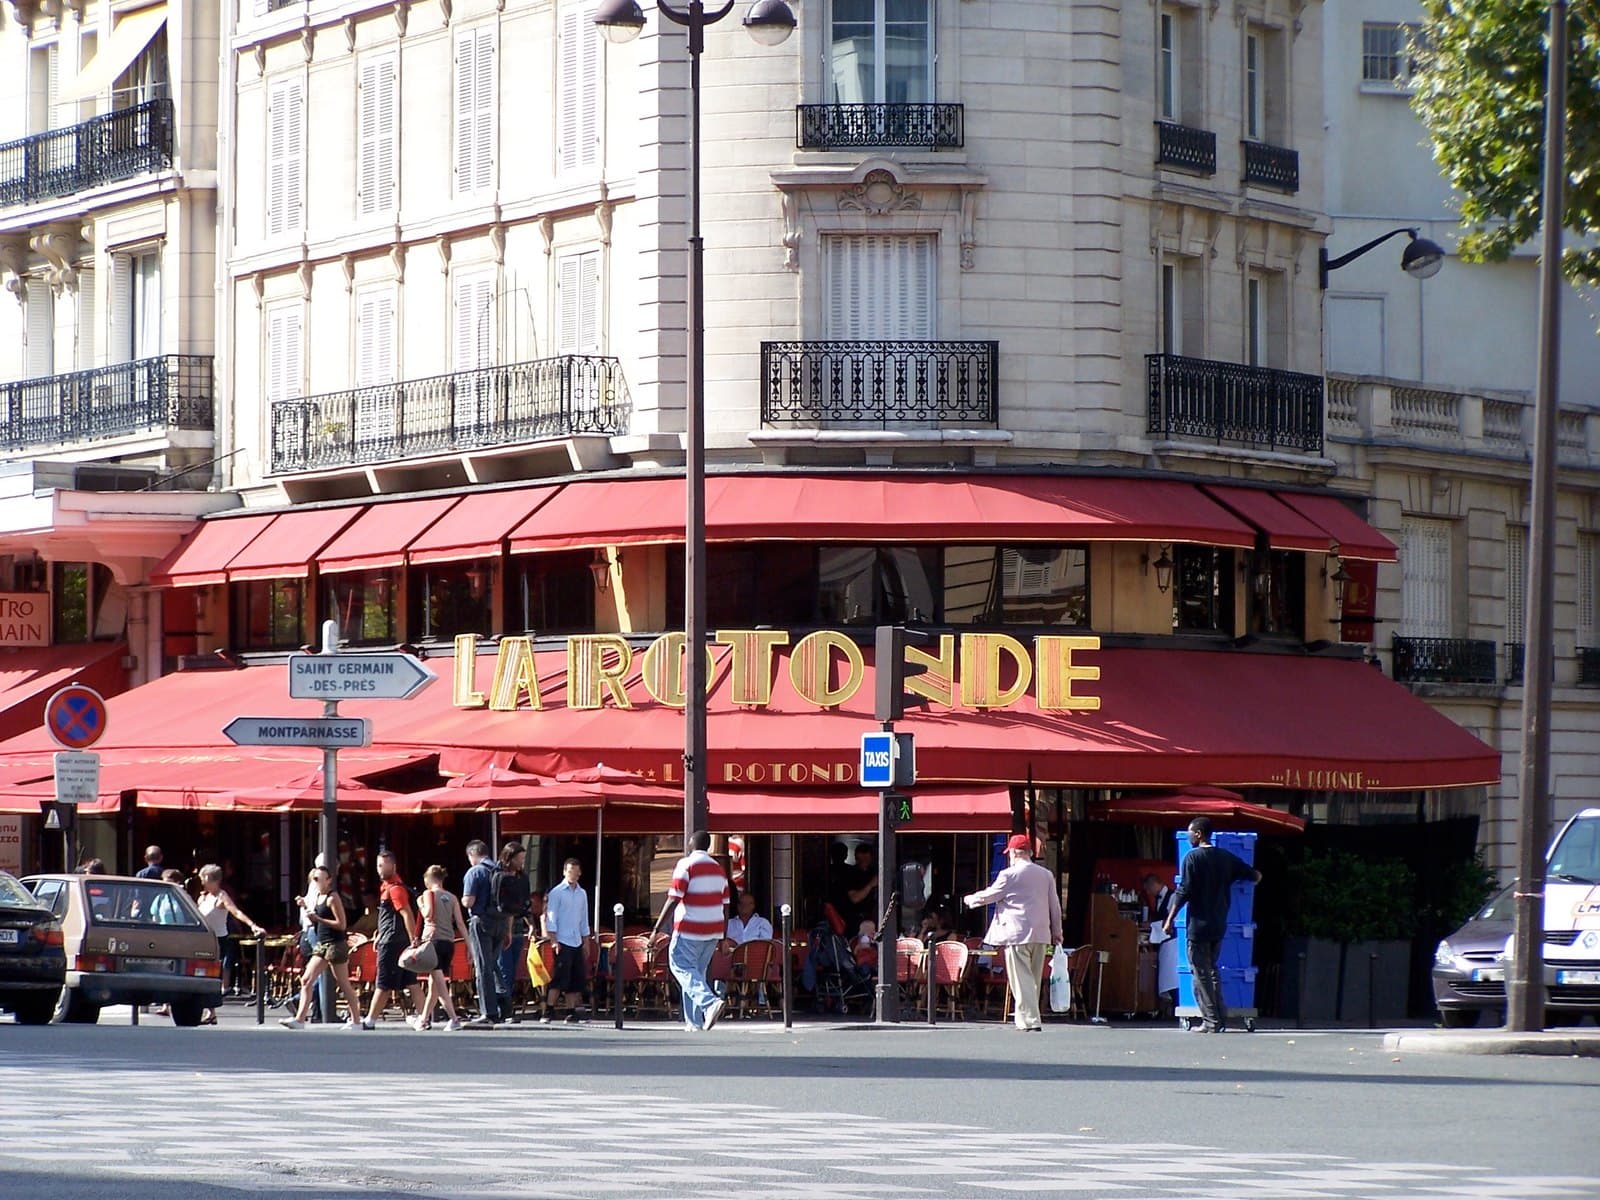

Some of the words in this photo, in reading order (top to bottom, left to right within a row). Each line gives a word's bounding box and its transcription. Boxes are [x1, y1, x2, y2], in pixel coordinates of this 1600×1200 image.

[296, 663, 333, 675] SAINT
[338, 663, 394, 675] GERMAIN
[453, 633, 543, 711] LA
[567, 629, 1101, 711] ROTONDE
[259, 726, 358, 738] MONTPARNASSE
[865, 751, 889, 767] TAXIS
[724, 762, 860, 782] ROTOND
[1285, 768, 1302, 788] LA
[1308, 769, 1362, 789] ROTONDE
